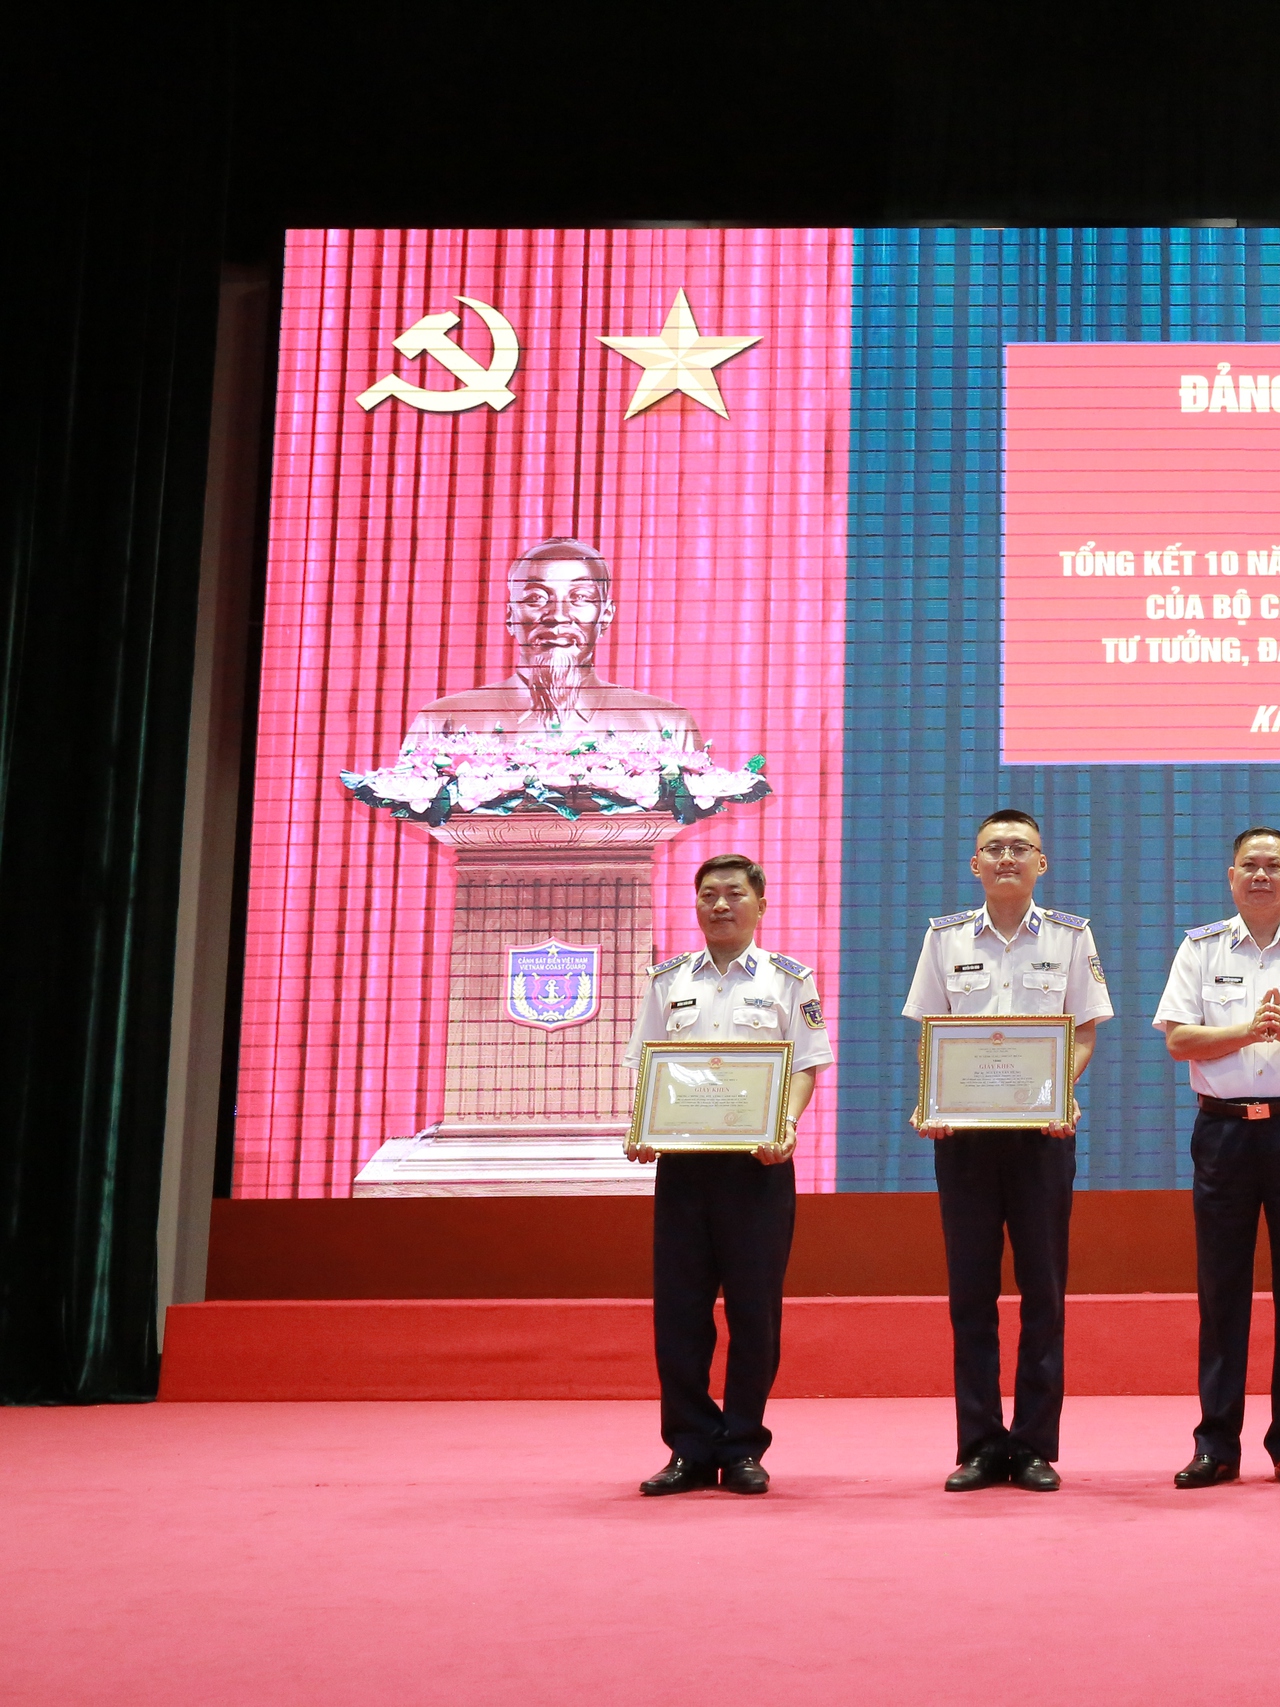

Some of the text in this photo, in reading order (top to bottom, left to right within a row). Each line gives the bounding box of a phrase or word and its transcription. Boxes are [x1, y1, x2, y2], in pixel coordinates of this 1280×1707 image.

[1059, 541, 1134, 577] TỔNG
[1143, 543, 1196, 576] KẾT
[1204, 551, 1239, 576] 10
[1146, 586, 1204, 620] CỦA
[1212, 589, 1251, 625] BỘ
[1102, 635, 1140, 663] TƯ
[1145, 629, 1249, 667] TƯỞNG,
[566, 963, 586, 971] GUARD
